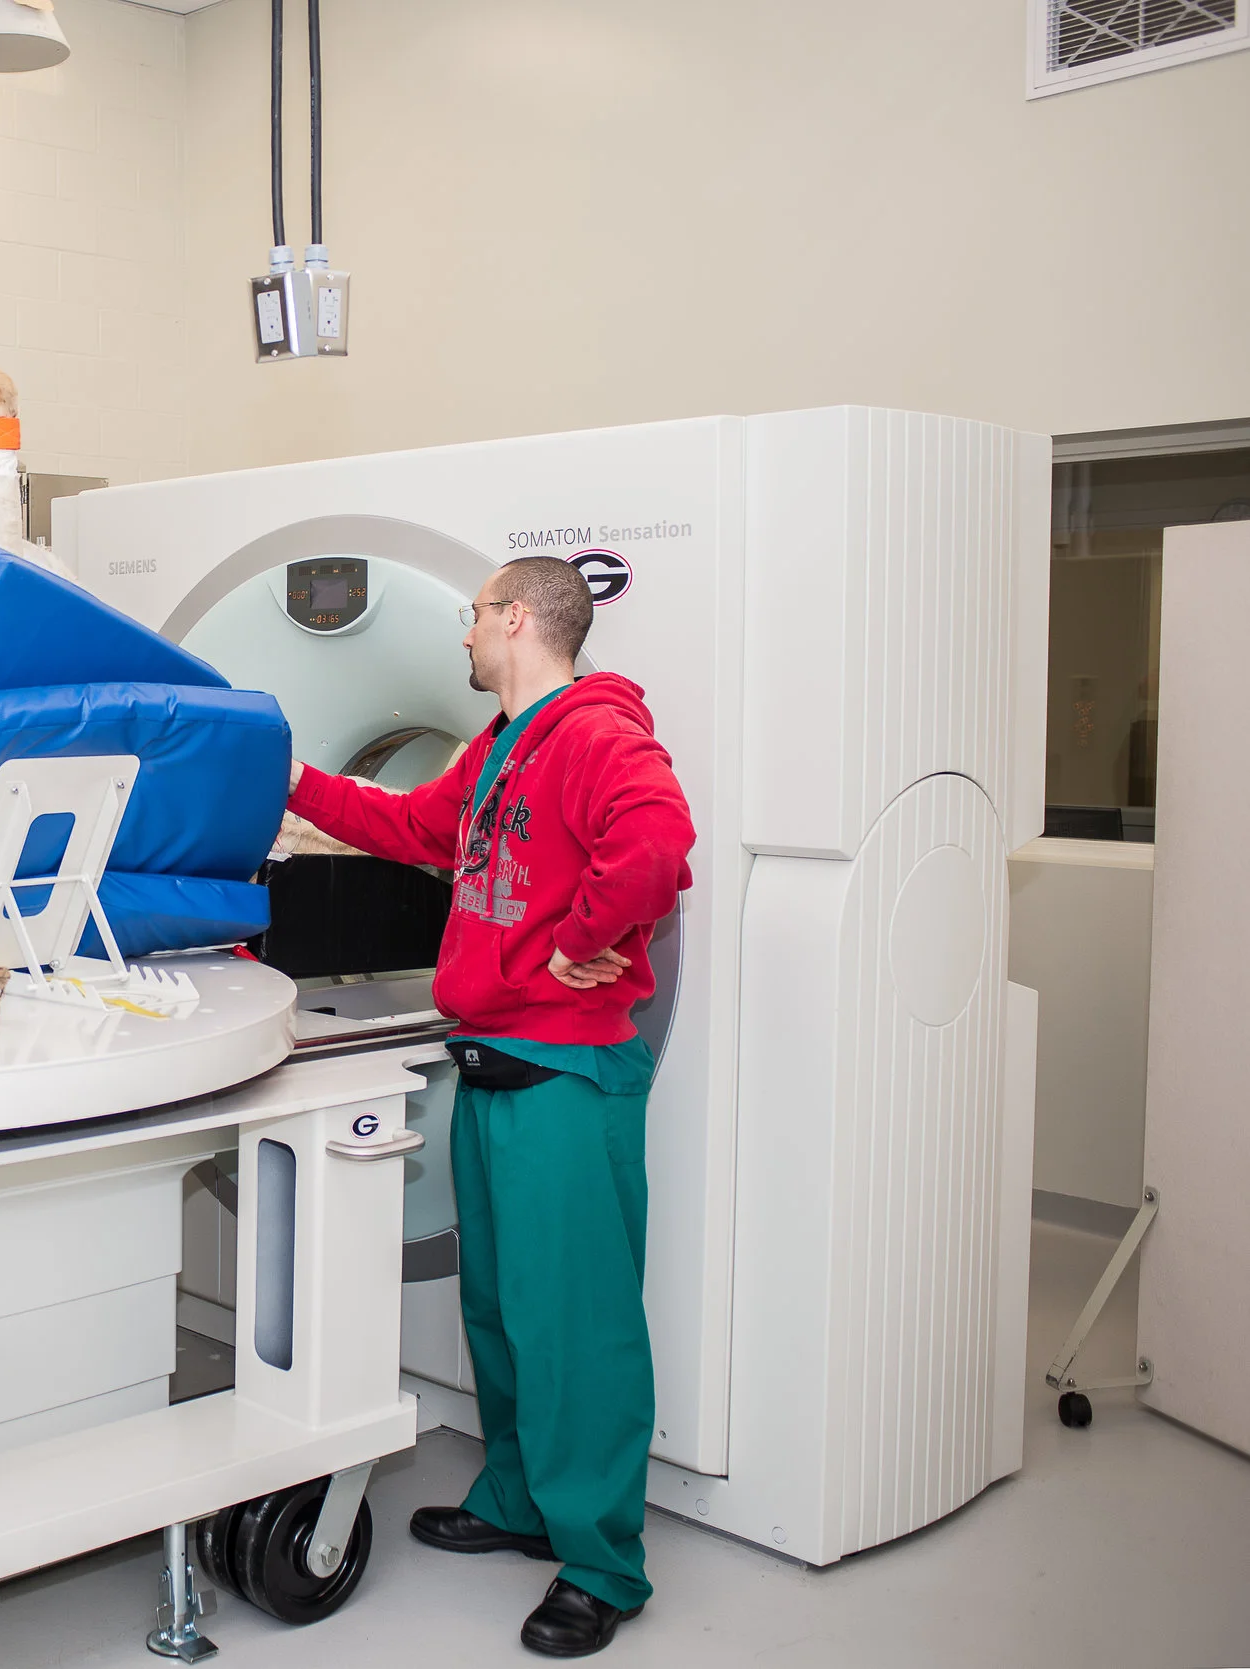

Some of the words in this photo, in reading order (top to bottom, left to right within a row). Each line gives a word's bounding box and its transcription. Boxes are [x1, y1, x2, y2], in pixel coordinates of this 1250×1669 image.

[508, 526, 592, 550] SOMATOM
[599, 519, 692, 543] Sensation
[108, 558, 157, 576] SIEMENS
[569, 553, 629, 602] G
[479, 793, 532, 841] Rck
[456, 893, 525, 917] EBELION
[352, 1114, 379, 1137] G
